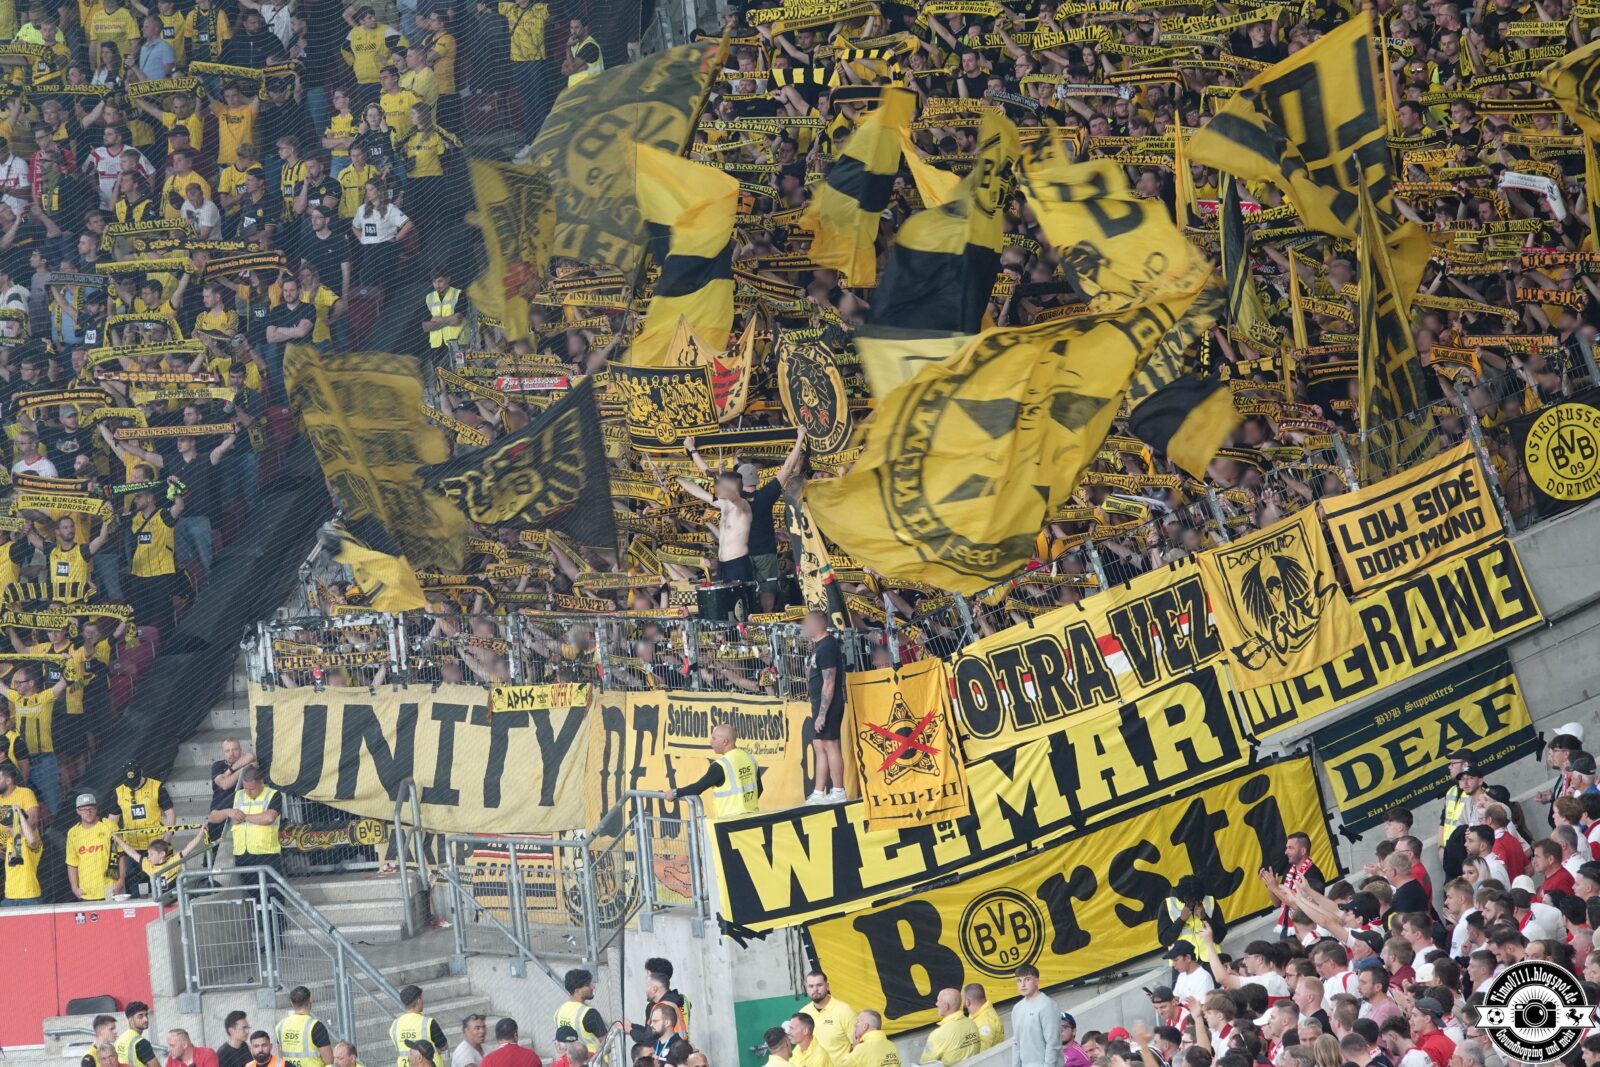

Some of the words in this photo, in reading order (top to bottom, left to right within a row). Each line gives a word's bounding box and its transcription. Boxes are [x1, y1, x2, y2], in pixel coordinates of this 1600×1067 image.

[759, 9, 783, 22] BAD
[784, 4, 839, 20] WIMPFEN
[1509, 50, 1527, 62] SIND
[364, 224, 377, 235] 1&1
[239, 256, 279, 266] Dortmund
[113, 339, 185, 351] DORTMUND
[119, 373, 194, 382] DORTMUND
[657, 426, 674, 437] BVB
[1528, 407, 1600, 463] OSTBORUSSE
[1551, 429, 1595, 470] BVB
[1570, 461, 1585, 475] 09
[1546, 469, 1600, 496] DORTMU
[30, 501, 55, 509] IMMER
[1339, 504, 1409, 554] LOW
[1412, 469, 1481, 525] SIDE
[1225, 533, 1296, 571] DORTMUND
[1356, 506, 1486, 580] DORTMUND
[953, 620, 1121, 740] OTRA
[1106, 573, 1224, 688] VEZ
[1404, 684, 1454, 712] Supporters
[667, 703, 709, 738] Sektion
[1332, 683, 1517, 803] DEAF
[255, 702, 586, 808] UNITY
[738, 766, 751, 775] SDS
[1367, 805, 1383, 819] Ein
[1384, 793, 1413, 812] Leben
[1414, 782, 1435, 800] lang
[131, 807, 145, 817] 1&1
[280, 823, 348, 850] Hessen
[358, 819, 383, 841] BVB
[973, 901, 1034, 957] BVB
[999, 946, 1020, 964] 09
[284, 1032, 300, 1040] SDS
[400, 1031, 417, 1040] SDS
